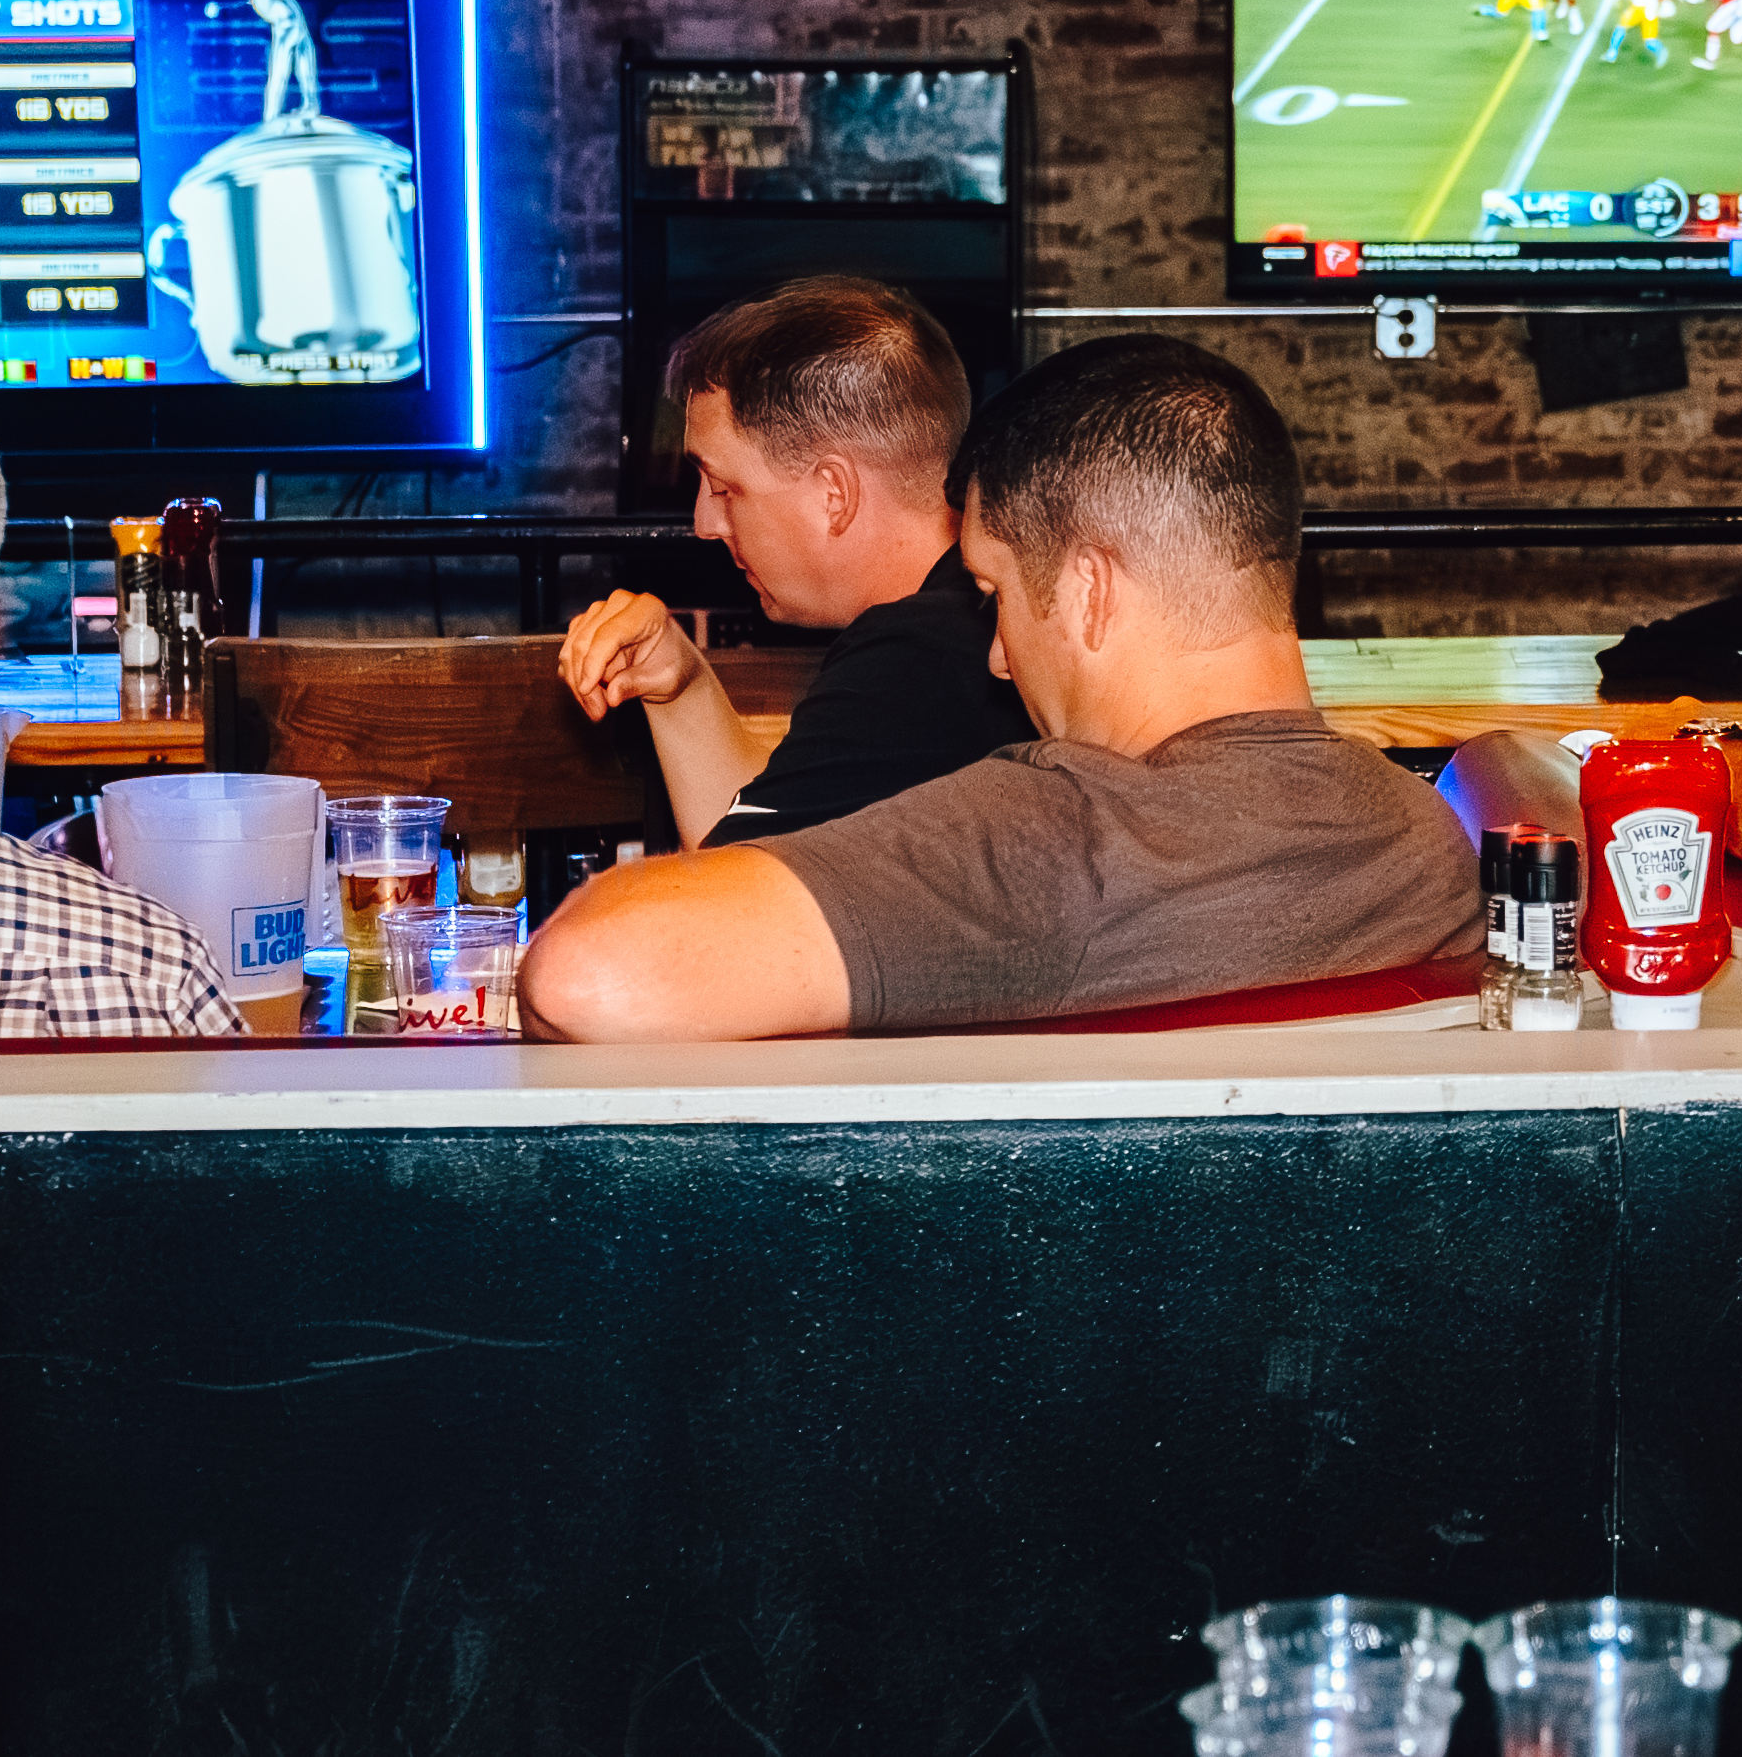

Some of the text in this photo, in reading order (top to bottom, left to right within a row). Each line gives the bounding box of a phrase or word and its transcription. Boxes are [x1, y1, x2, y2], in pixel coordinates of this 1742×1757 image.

[1588, 194, 1614, 222] 0
[1696, 193, 1721, 222] 3
[1632, 824, 1681, 843] HEINZ
[1631, 847, 1687, 865] TOMATO
[1636, 861, 1686, 875] KETCHUP
[255, 907, 305, 940] BUD
[396, 985, 487, 1033] ive!
